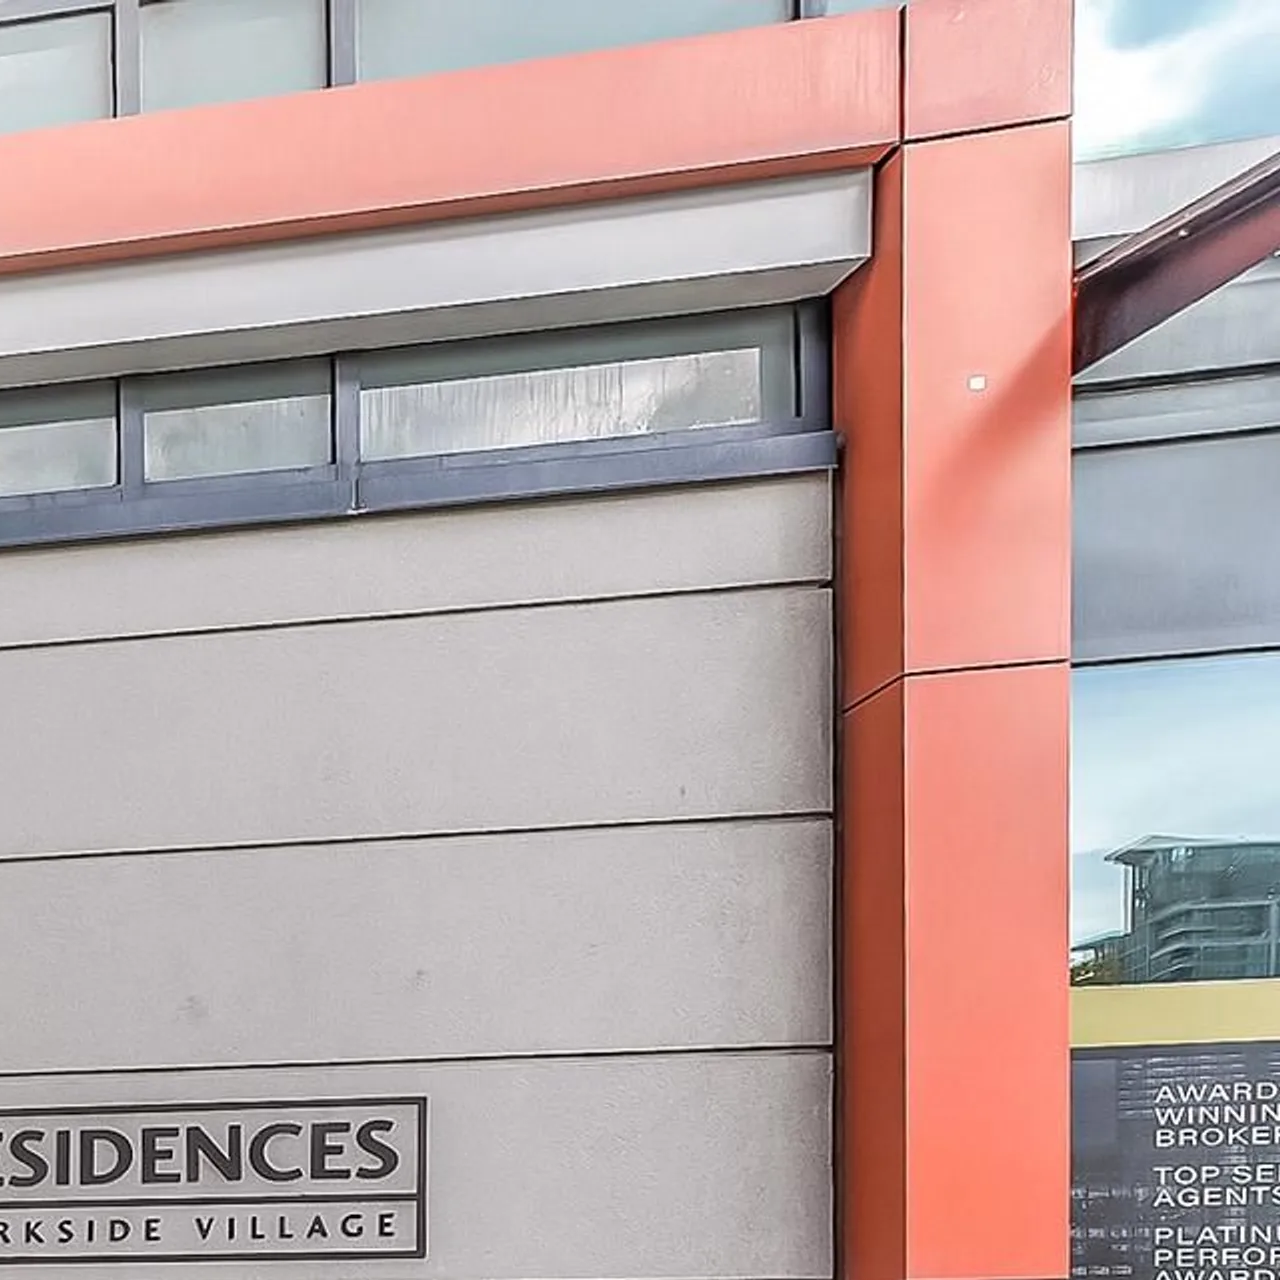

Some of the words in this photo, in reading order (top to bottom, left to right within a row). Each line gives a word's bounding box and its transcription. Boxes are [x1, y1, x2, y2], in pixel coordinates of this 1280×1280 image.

[1153, 1165, 1220, 1186] TOP
[1232, 1163, 1280, 1185] SE
[195, 1212, 397, 1242] VILLAGE
[1155, 1225, 1280, 1245] PLATIN
